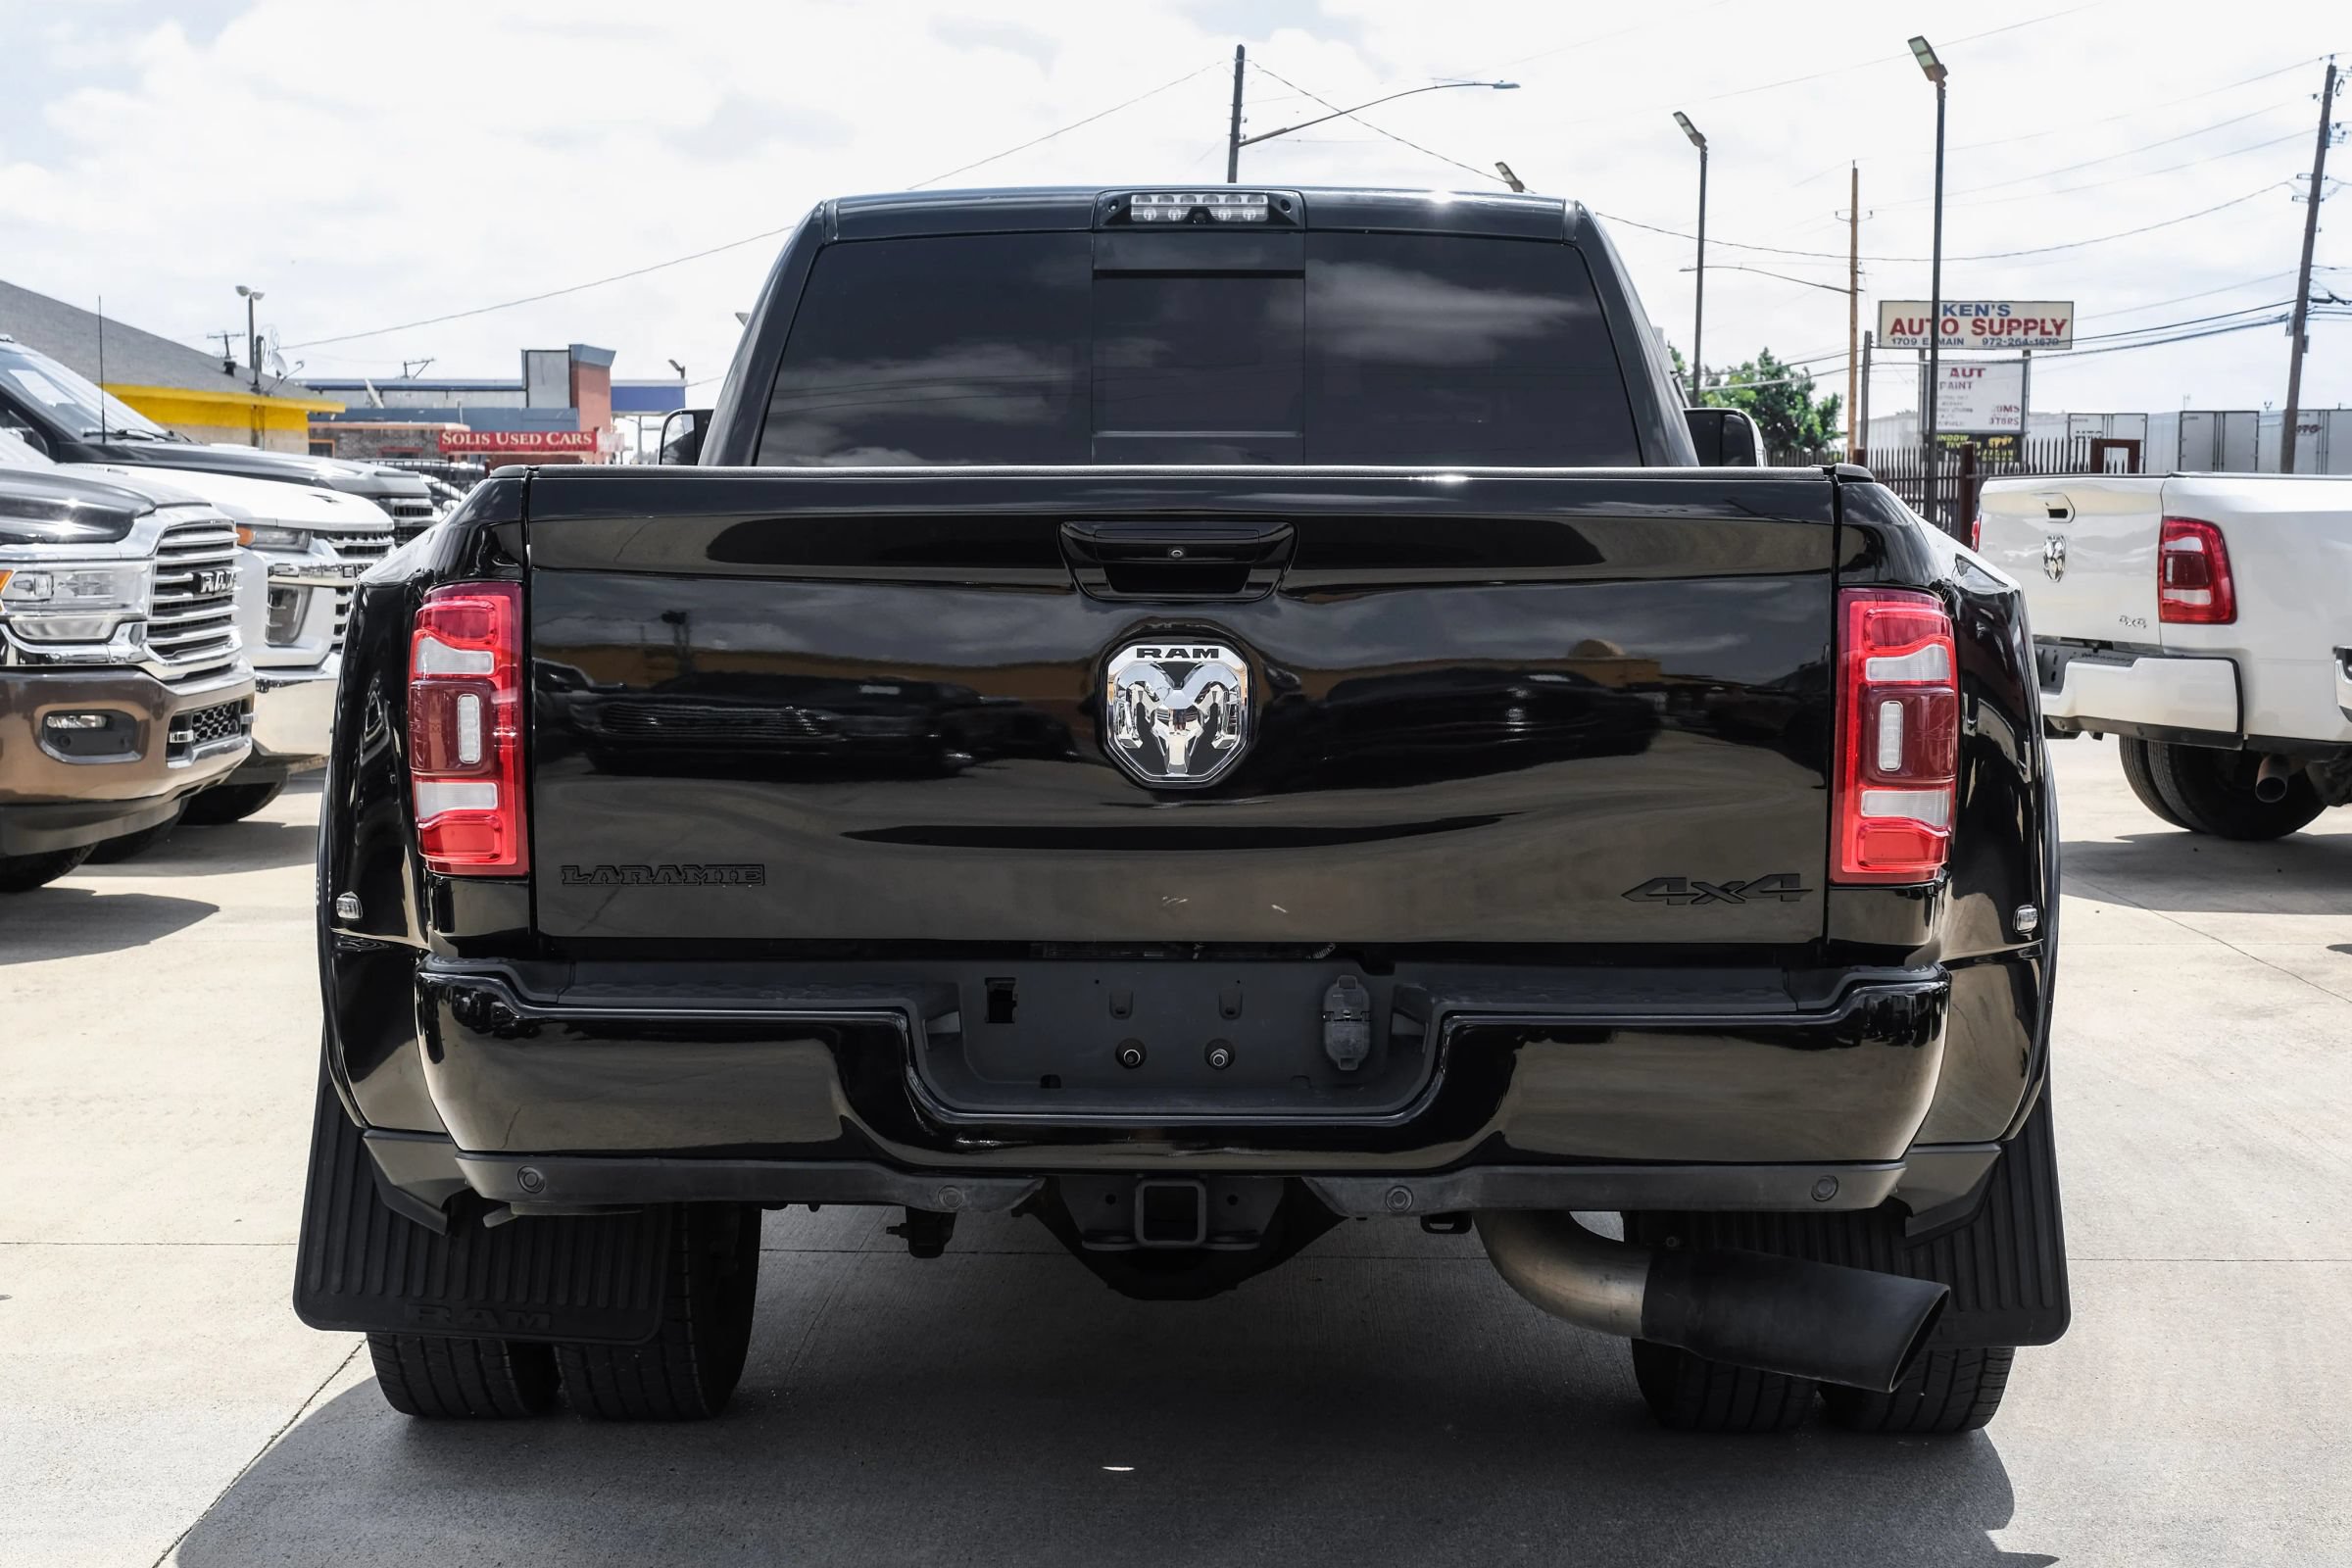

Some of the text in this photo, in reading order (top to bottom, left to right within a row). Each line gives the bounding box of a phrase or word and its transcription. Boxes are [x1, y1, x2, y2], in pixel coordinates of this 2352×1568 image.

[1942, 304, 2011, 317] KEN'S
[1971, 318, 2068, 336] SUPPLY
[1891, 337, 1918, 346] 1709
[441, 431, 593, 446] SOLIS USED CARS
[1136, 648, 1220, 660] RAM
[561, 864, 765, 887] LARAMIE
[406, 1302, 555, 1332] RAM
